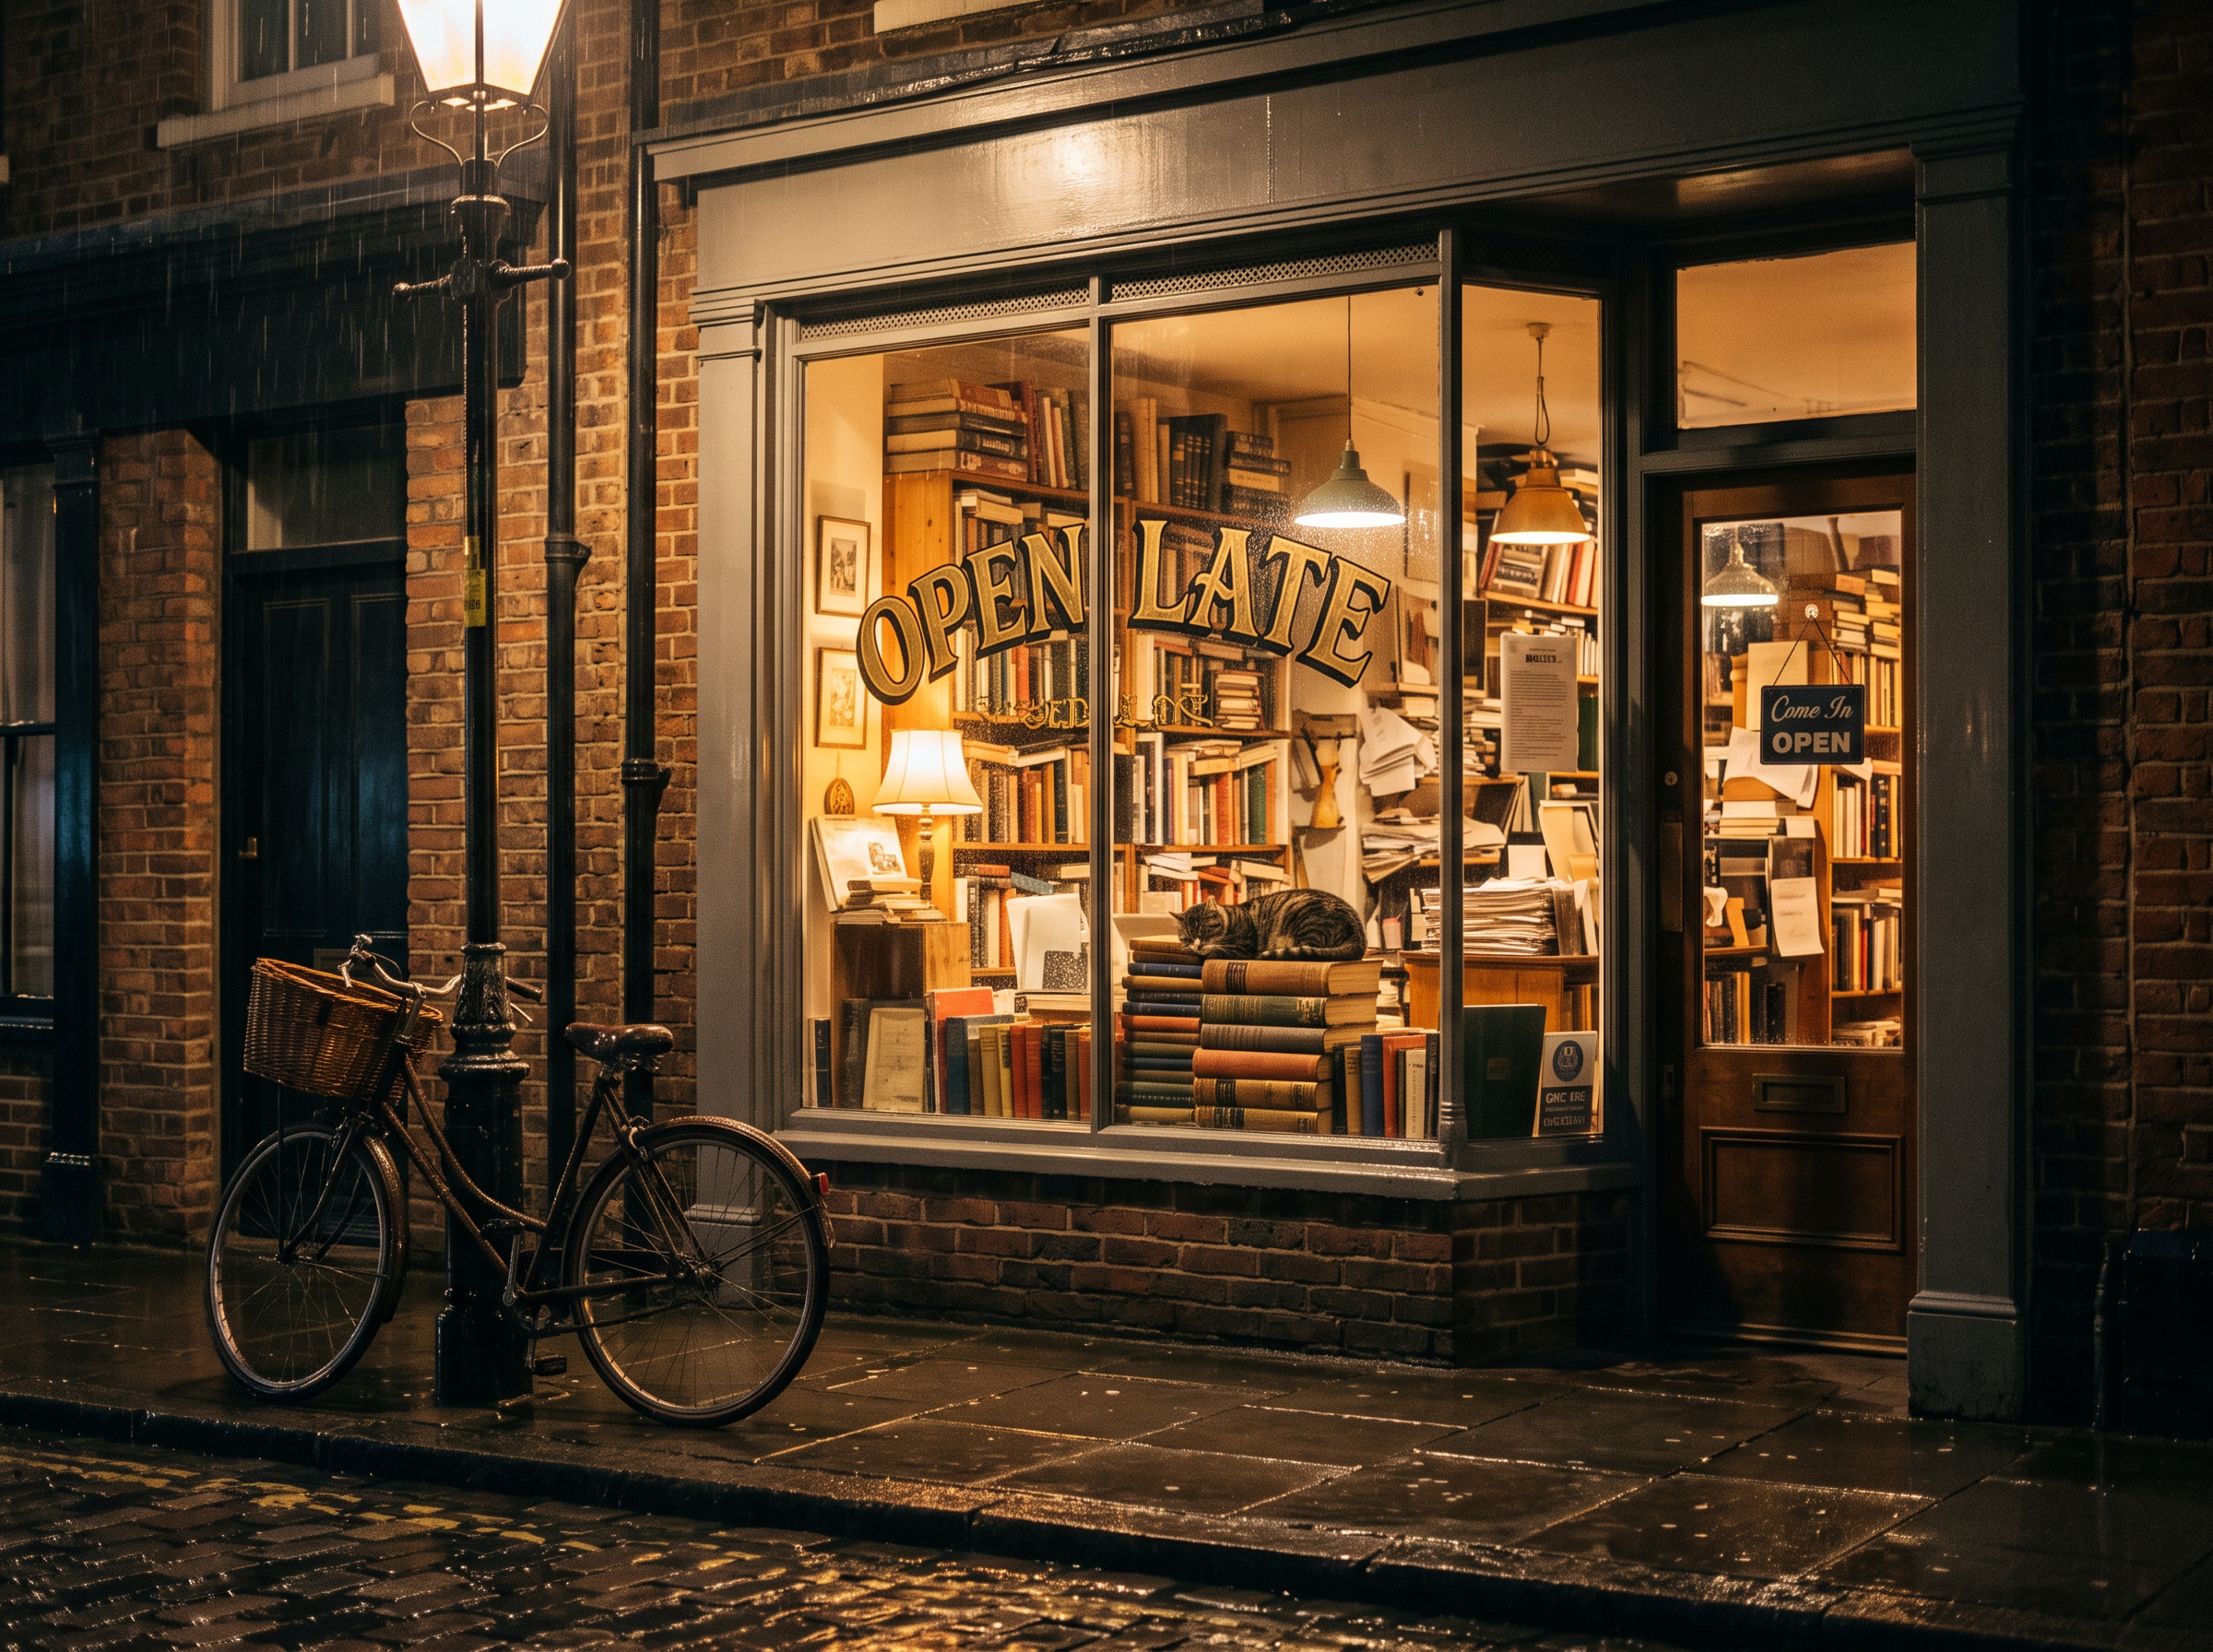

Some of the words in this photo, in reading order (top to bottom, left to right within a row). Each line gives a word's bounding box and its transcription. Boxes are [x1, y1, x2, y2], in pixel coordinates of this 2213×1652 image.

[857, 524, 1085, 706] OPEN
[1127, 519, 1391, 689] LATE
[1771, 695, 1821, 722] Come
[1824, 695, 1853, 719] In
[1772, 731, 1851, 754] OPEN
